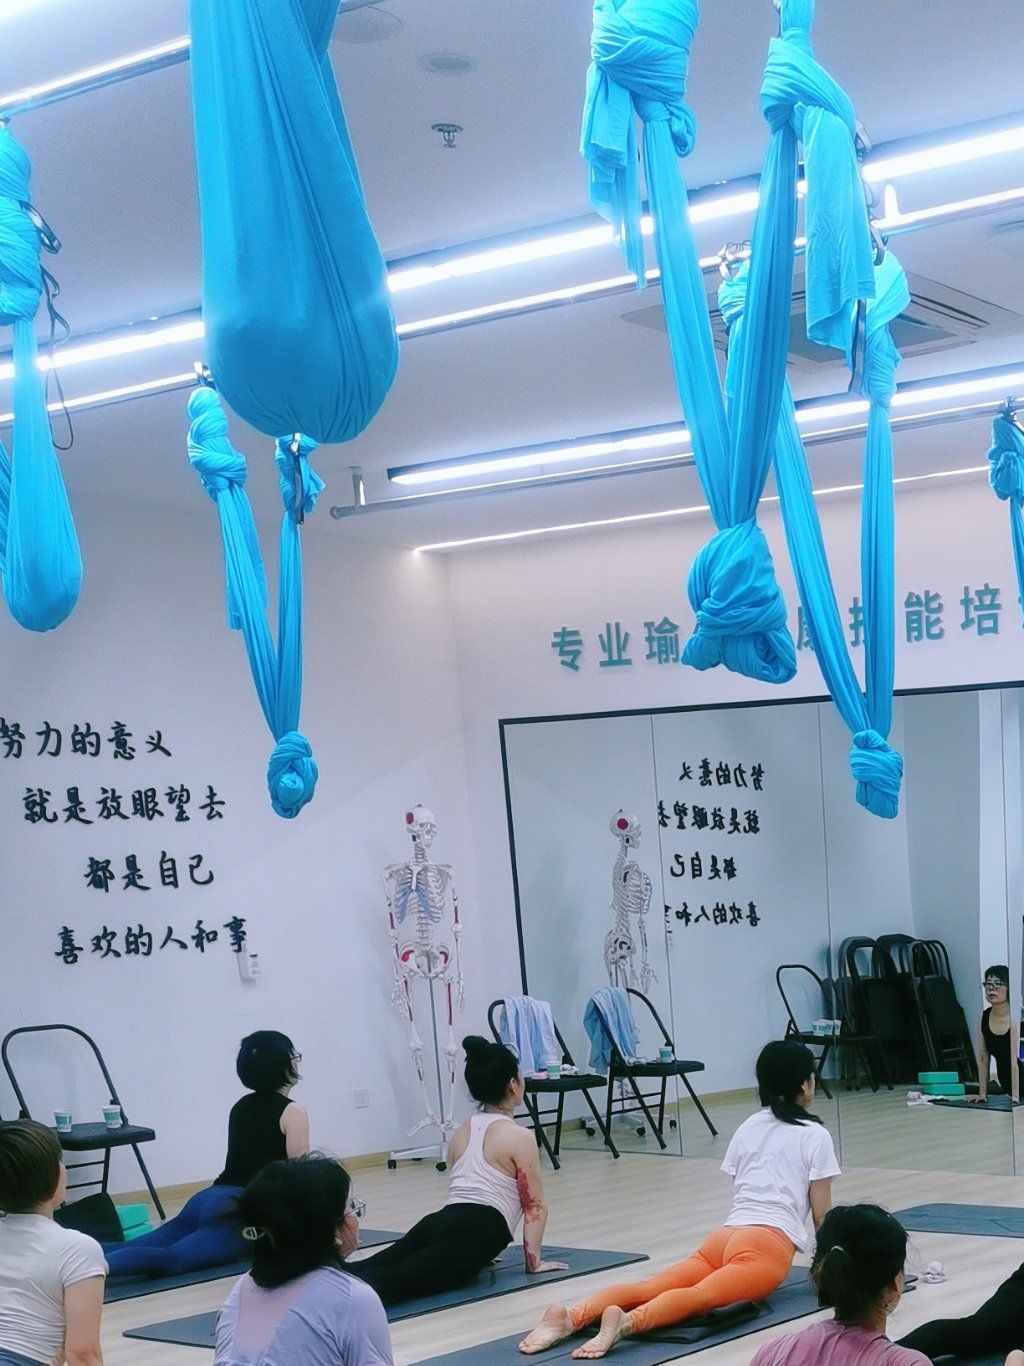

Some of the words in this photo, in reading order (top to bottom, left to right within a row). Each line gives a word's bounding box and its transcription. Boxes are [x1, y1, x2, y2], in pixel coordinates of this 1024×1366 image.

[0, 717, 172, 760] 努力的意义
[22, 784, 226, 825] 就是放眼望去
[84, 851, 215, 893] 都是自己
[54, 915, 248, 964] 喜欢的人和事
